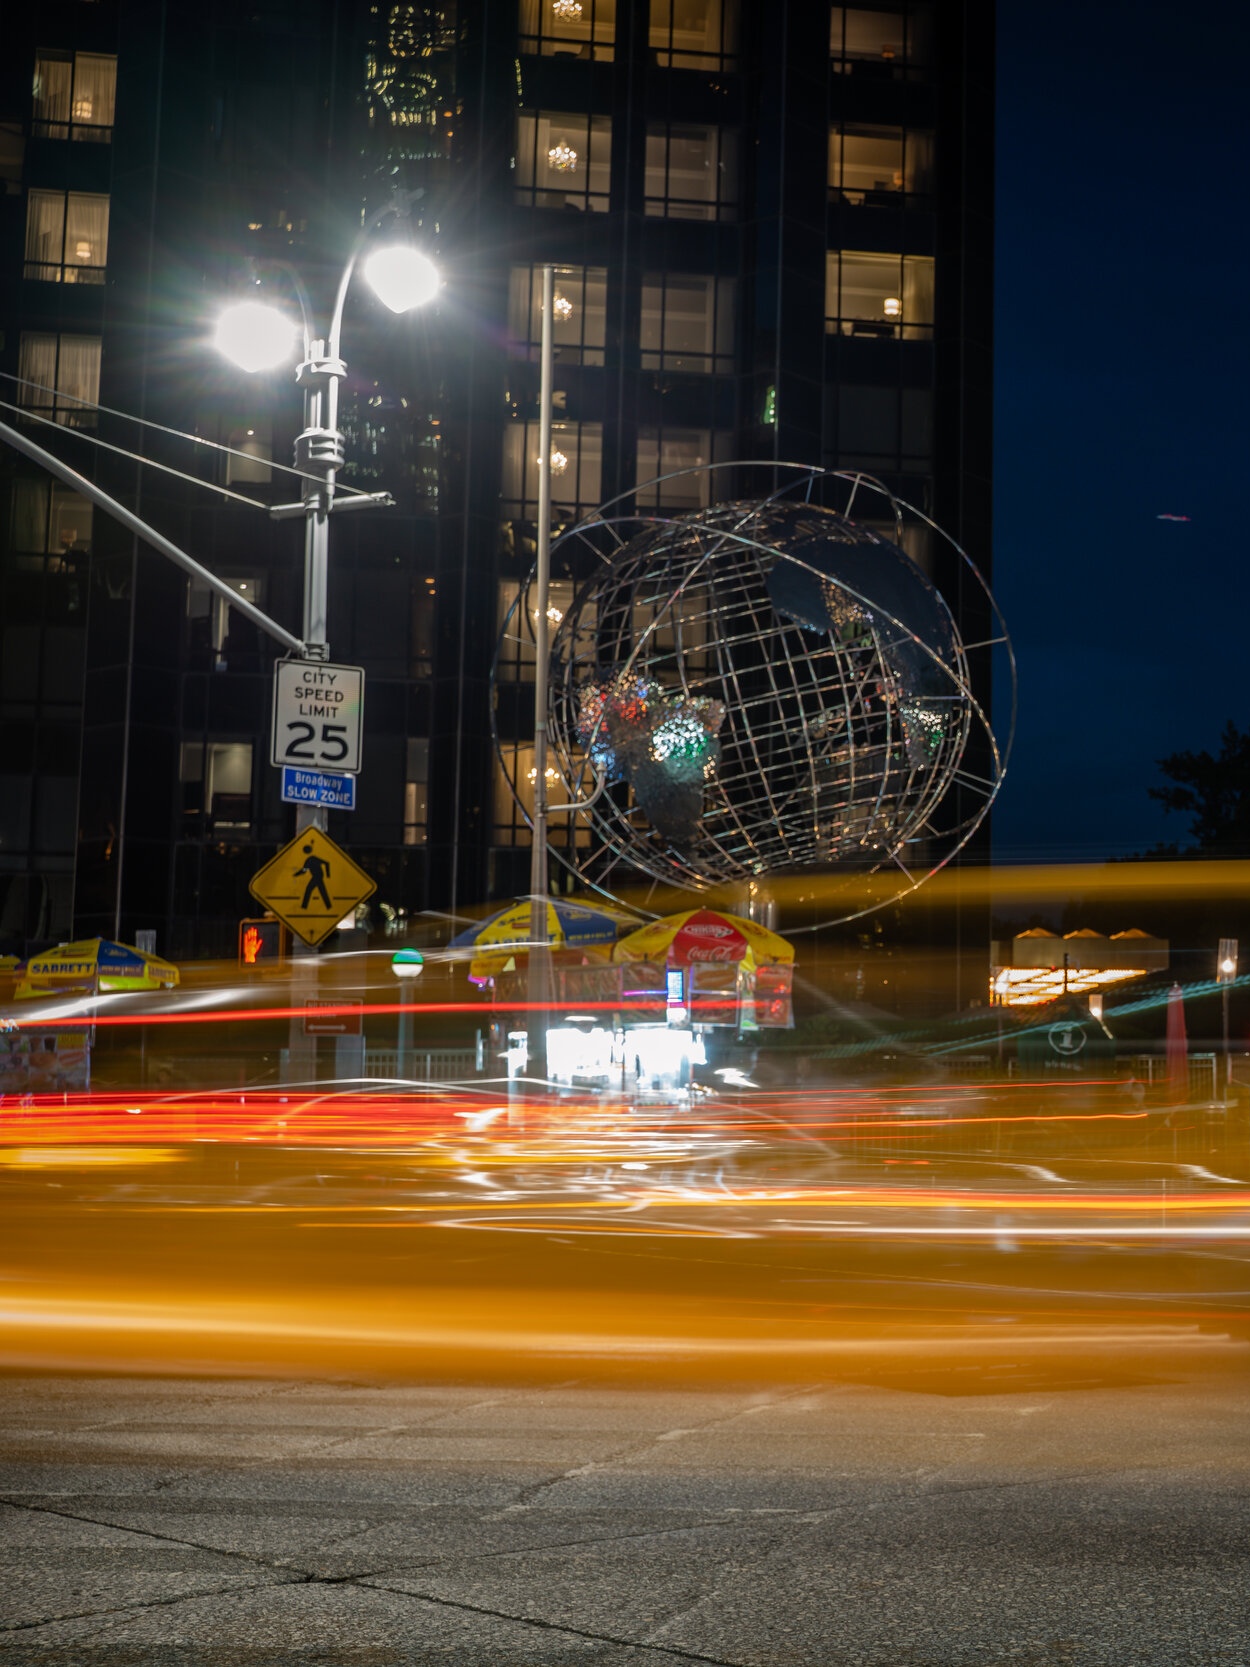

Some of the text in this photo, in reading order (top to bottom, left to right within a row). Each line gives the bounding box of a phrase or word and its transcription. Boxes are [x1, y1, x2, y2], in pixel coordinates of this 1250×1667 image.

[302, 671, 338, 685] CITY
[294, 686, 344, 703] SPEED
[299, 703, 339, 718] LIMIT
[285, 721, 349, 761] 25
[295, 771, 343, 790] Broadway
[287, 785, 351, 805] SLOW ZONE
[32, 962, 92, 975] SABRETT
